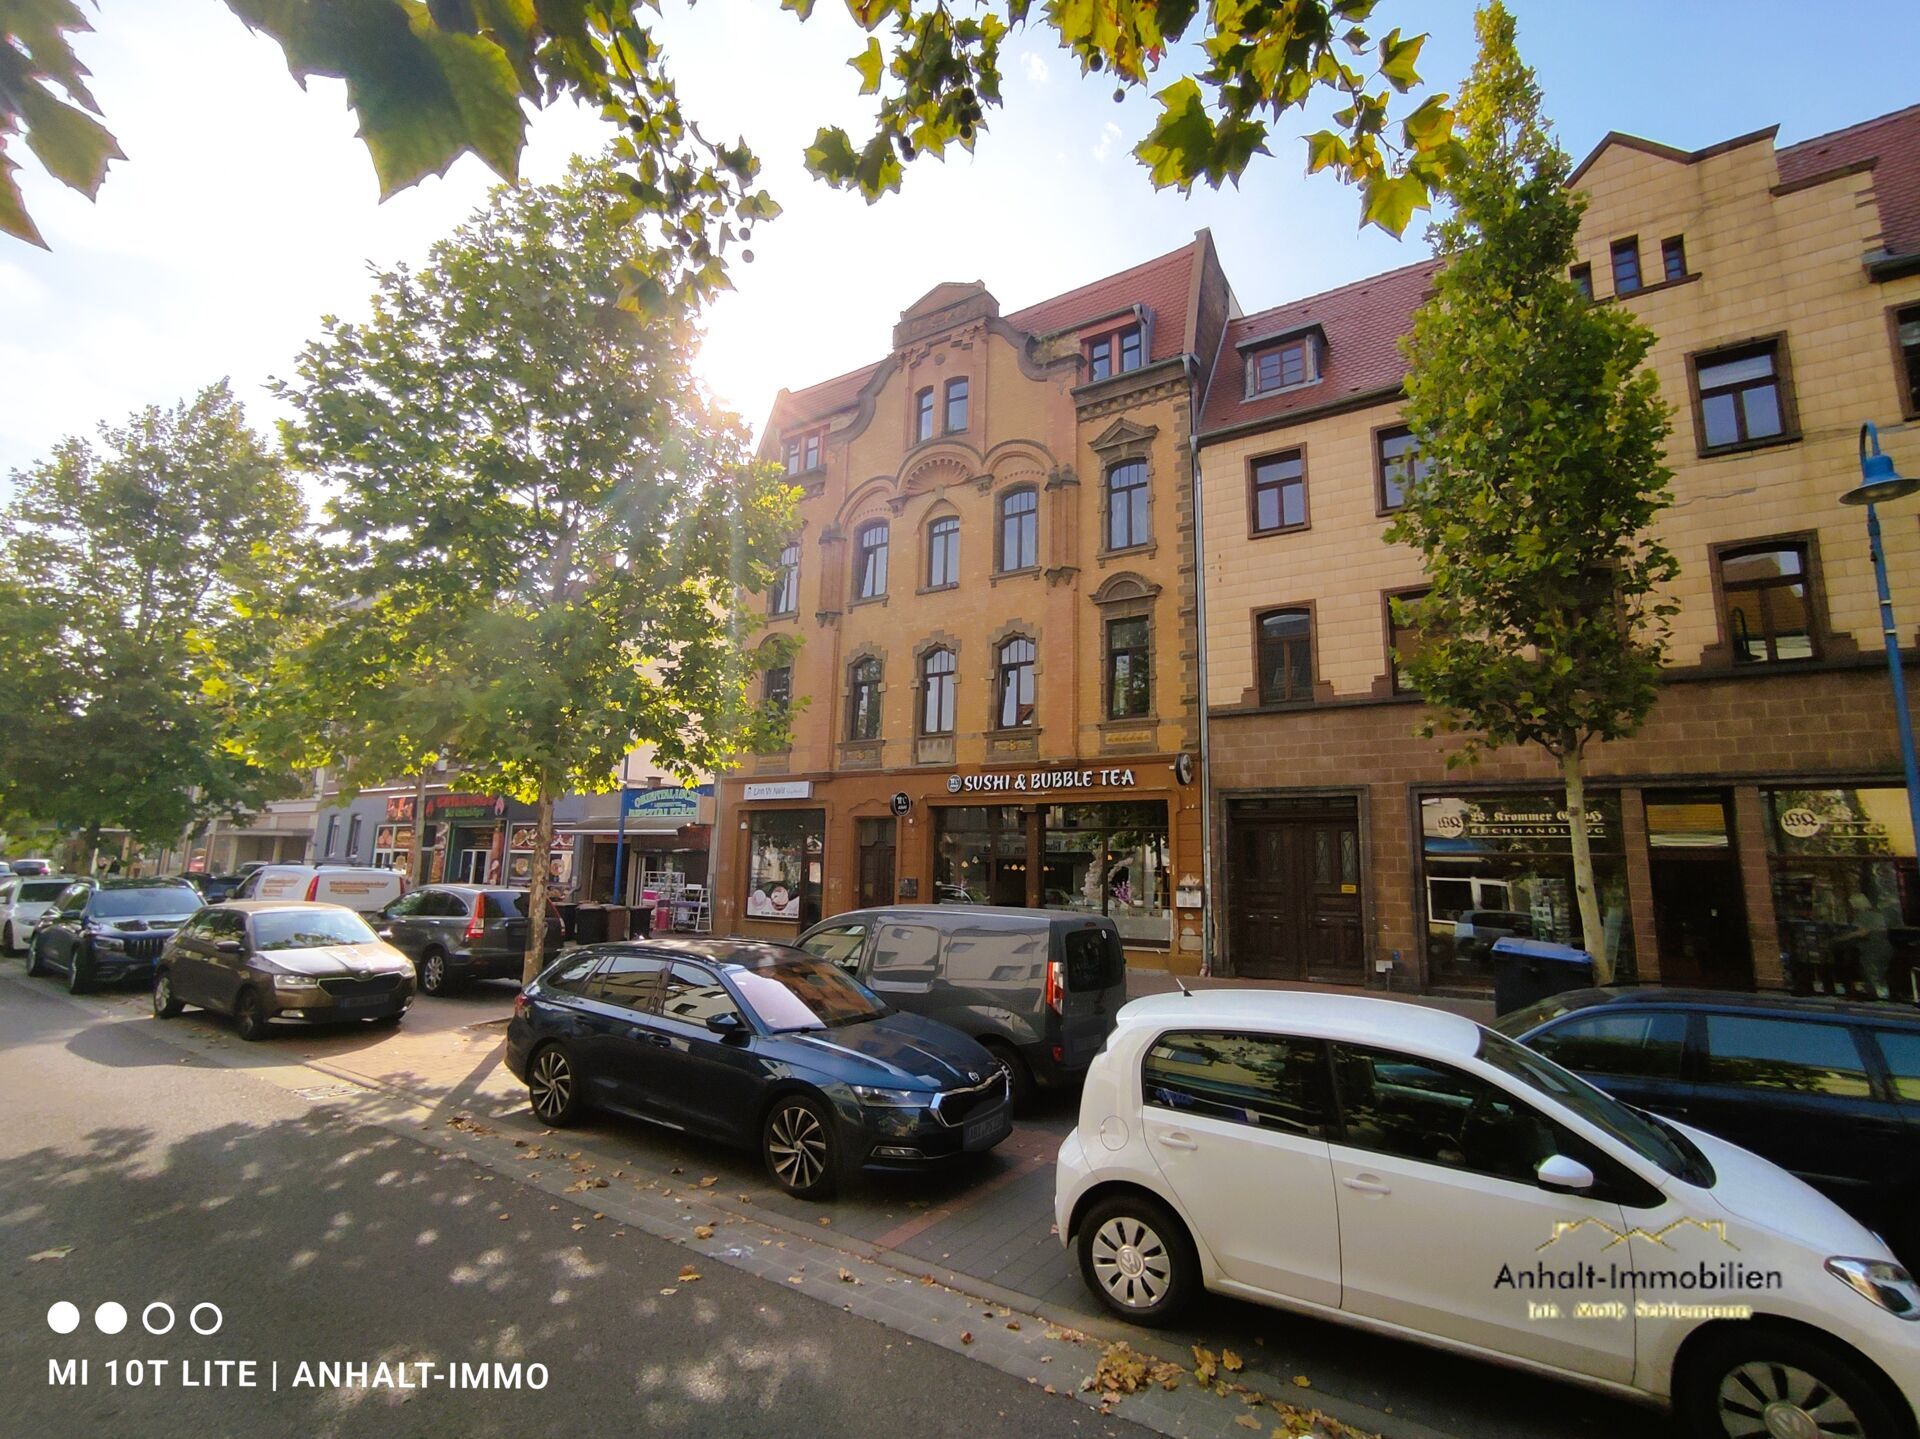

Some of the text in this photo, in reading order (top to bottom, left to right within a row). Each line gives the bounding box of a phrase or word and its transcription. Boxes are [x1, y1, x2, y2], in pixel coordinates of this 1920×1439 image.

[964, 774, 1010, 792] SUSHI
[1015, 773, 1026, 791] &
[1031, 770, 1093, 789] BUBBLE
[1101, 769, 1135, 786] TEA
[1494, 811, 1552, 822] Krommer
[1556, 811, 1602, 823] GH
[1472, 826, 1604, 835] BUCHHANDLNG
